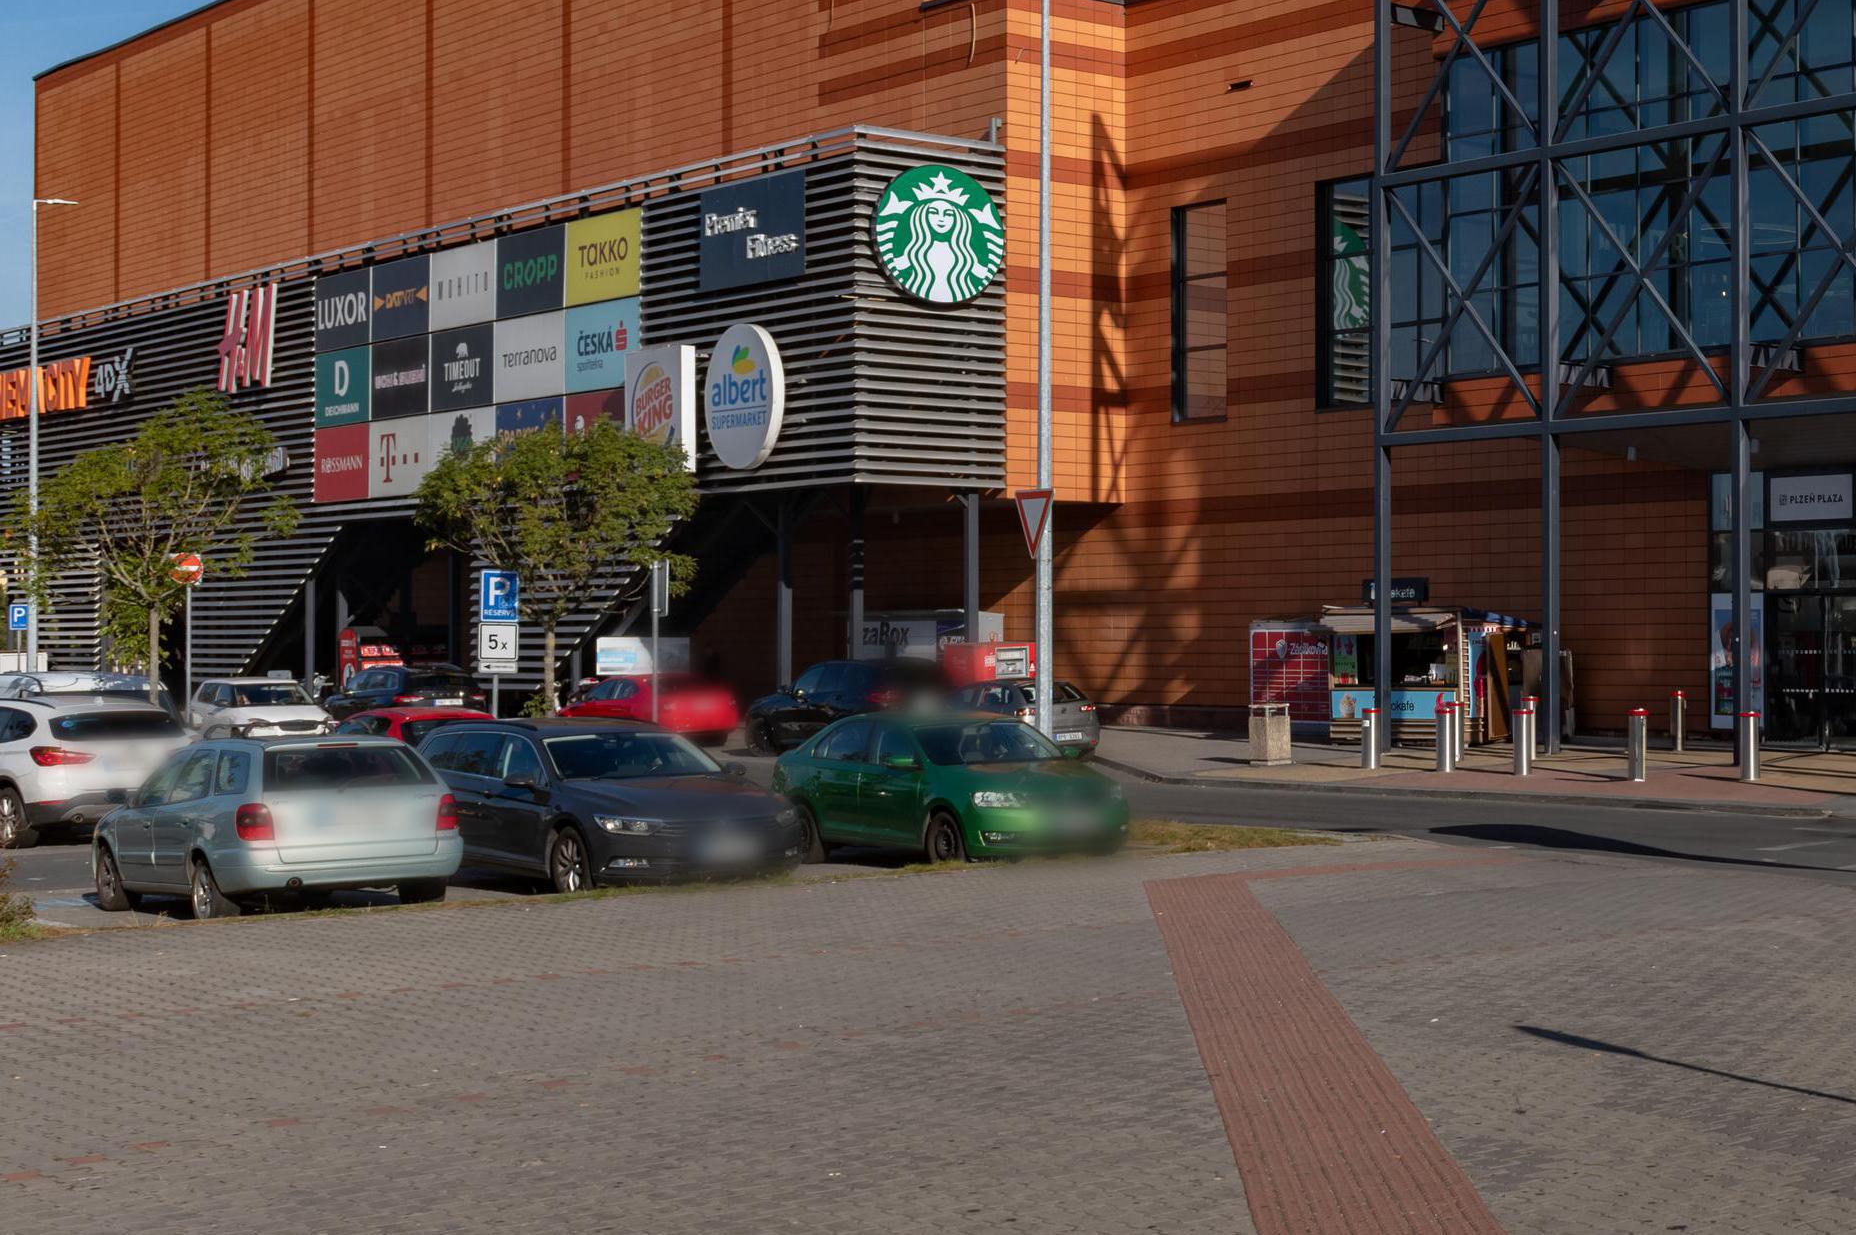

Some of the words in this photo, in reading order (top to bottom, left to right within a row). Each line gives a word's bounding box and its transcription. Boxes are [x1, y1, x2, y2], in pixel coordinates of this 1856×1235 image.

[705, 207, 757, 236] Premier
[746, 233, 799, 259] Fitness
[437, 271, 488, 301] MOHITO
[503, 253, 558, 291] CROPP
[585, 267, 620, 280] FASHION
[318, 291, 368, 330] LUXOR
[577, 326, 614, 357] ČESKÁ
[444, 358, 481, 382] TIMEOUT
[502, 346, 557, 368] terranova
[635, 376, 672, 415] BURGER
[712, 369, 767, 407] albert
[325, 402, 360, 417] DEICHMANN
[636, 394, 673, 433] KING
[711, 410, 767, 431] SUPERMARKET
[321, 455, 363, 474] ROSSMANN
[1789, 492, 1815, 504] PLZEŇ
[1817, 493, 1844, 504] PLAZA
[489, 577, 510, 606] P
[14, 607, 25, 623] P
[863, 621, 910, 649] zaBox
